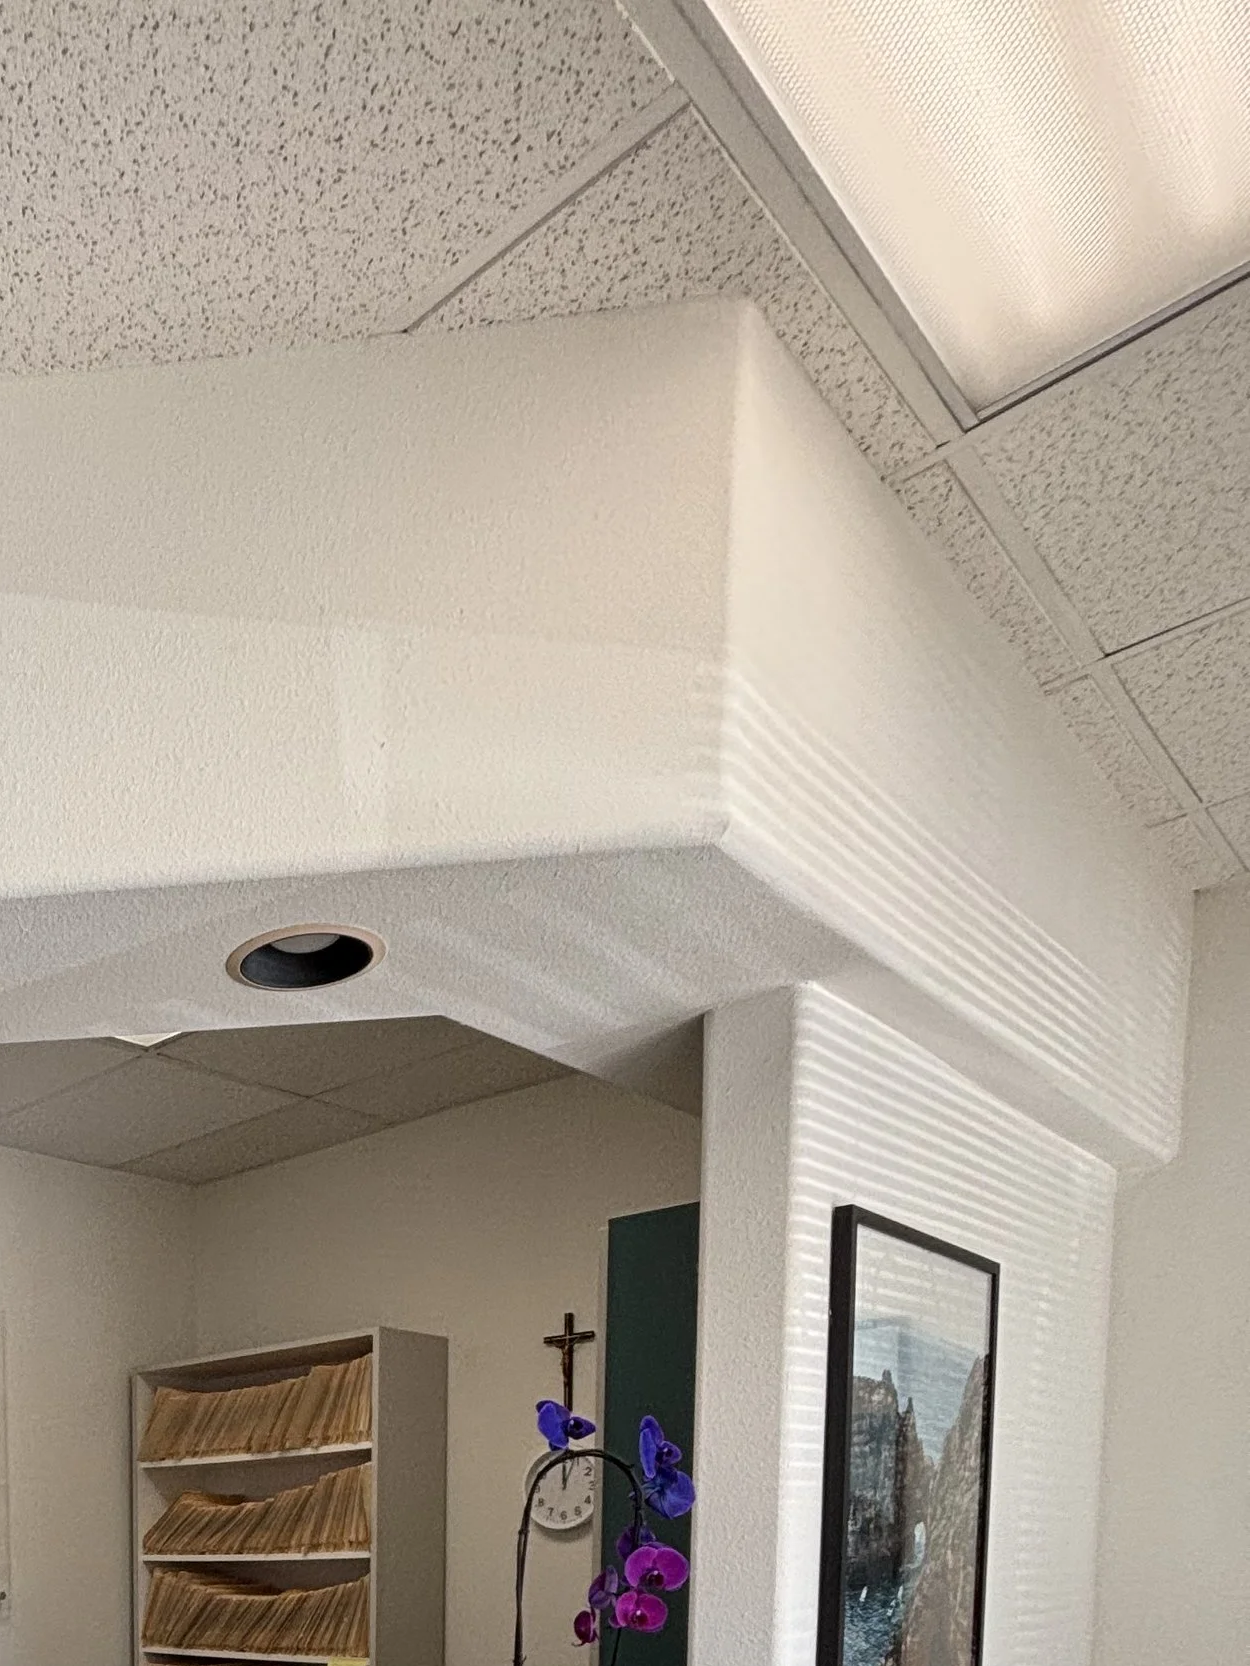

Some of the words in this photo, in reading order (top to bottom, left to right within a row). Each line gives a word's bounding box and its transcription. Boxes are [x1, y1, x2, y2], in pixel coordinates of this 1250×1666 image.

[583, 1467, 592, 1477] 2
[584, 1494, 591, 1504] 4
[548, 1507, 554, 1516] 7
[560, 1510, 567, 1520] 6
